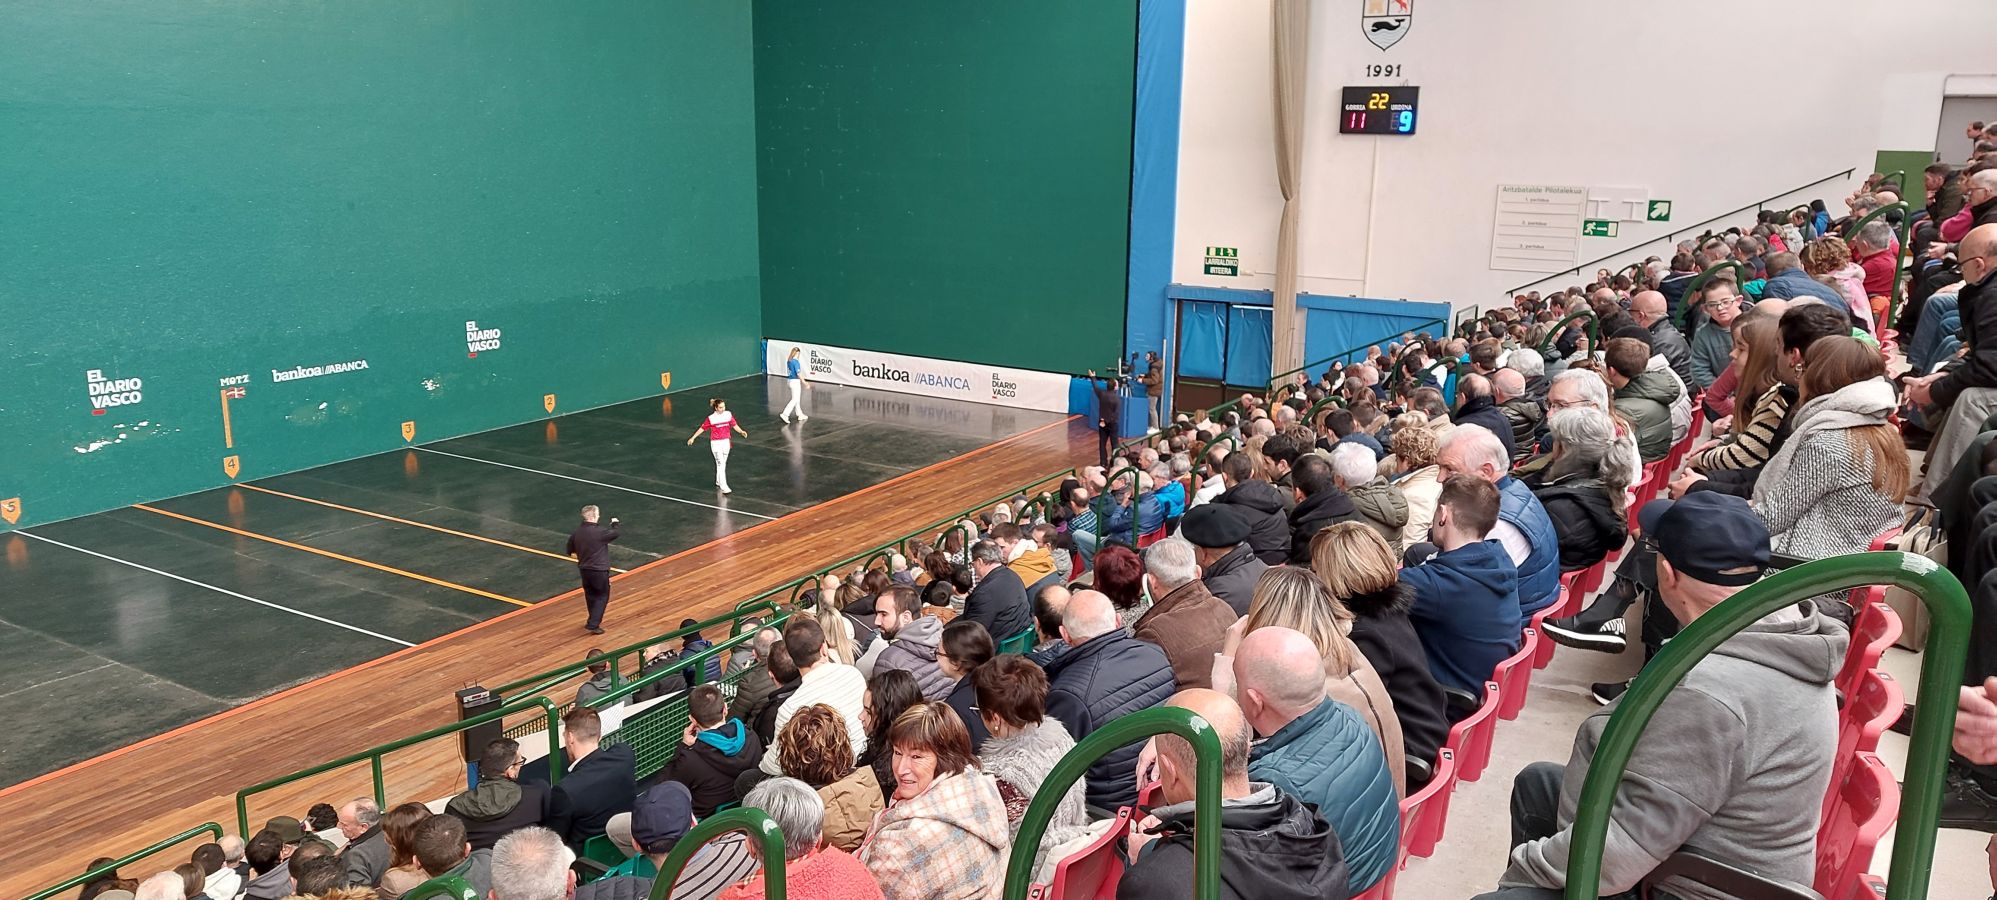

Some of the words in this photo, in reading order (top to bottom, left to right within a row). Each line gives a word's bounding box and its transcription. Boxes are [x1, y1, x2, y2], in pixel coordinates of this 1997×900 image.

[1366, 64, 1401, 77] 1991
[1369, 93, 1389, 109] 22
[1350, 112, 1366, 128] 11
[1398, 111, 1412, 131] 9
[466, 321, 479, 331] EL
[467, 329, 501, 341] DIARIO
[467, 339, 500, 352] VASCO
[810, 350, 819, 358] EL
[810, 358, 832, 367] DIARIO
[272, 365, 322, 382] bankoa
[810, 365, 832, 373] VASCO
[852, 360, 910, 383] bankoa
[87, 369, 107, 382] EL
[220, 374, 249, 386] MOTZ
[992, 372, 1000, 380] EL
[89, 378, 142, 396] DIARIO
[992, 380, 1016, 390] DIARIO
[992, 388, 1015, 397] VASCO
[90, 391, 142, 408] VASCO
[227, 458, 236, 468] 4
